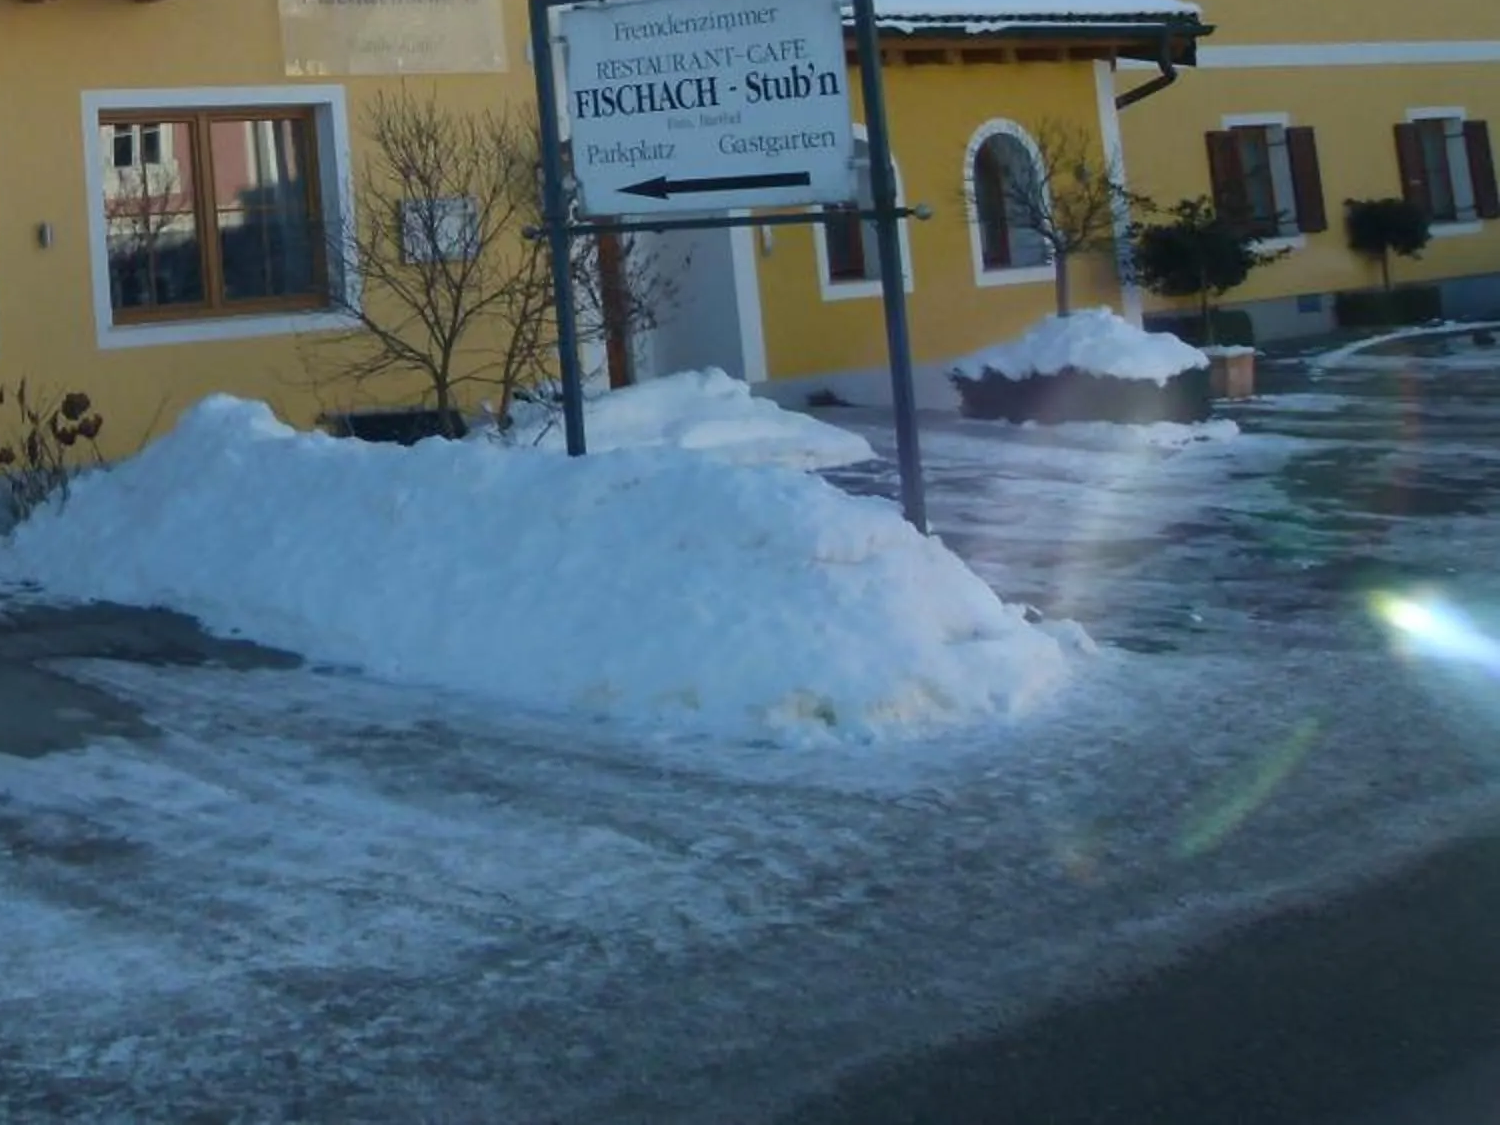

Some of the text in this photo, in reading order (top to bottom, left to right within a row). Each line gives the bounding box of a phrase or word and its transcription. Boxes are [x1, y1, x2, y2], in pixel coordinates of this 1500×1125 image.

[614, 6, 778, 42] Fremdenzimmer
[574, 76, 720, 119] FISCHACH
[745, 62, 840, 104] Stub'n
[587, 129, 836, 168] Parkplatz Gastgarten
